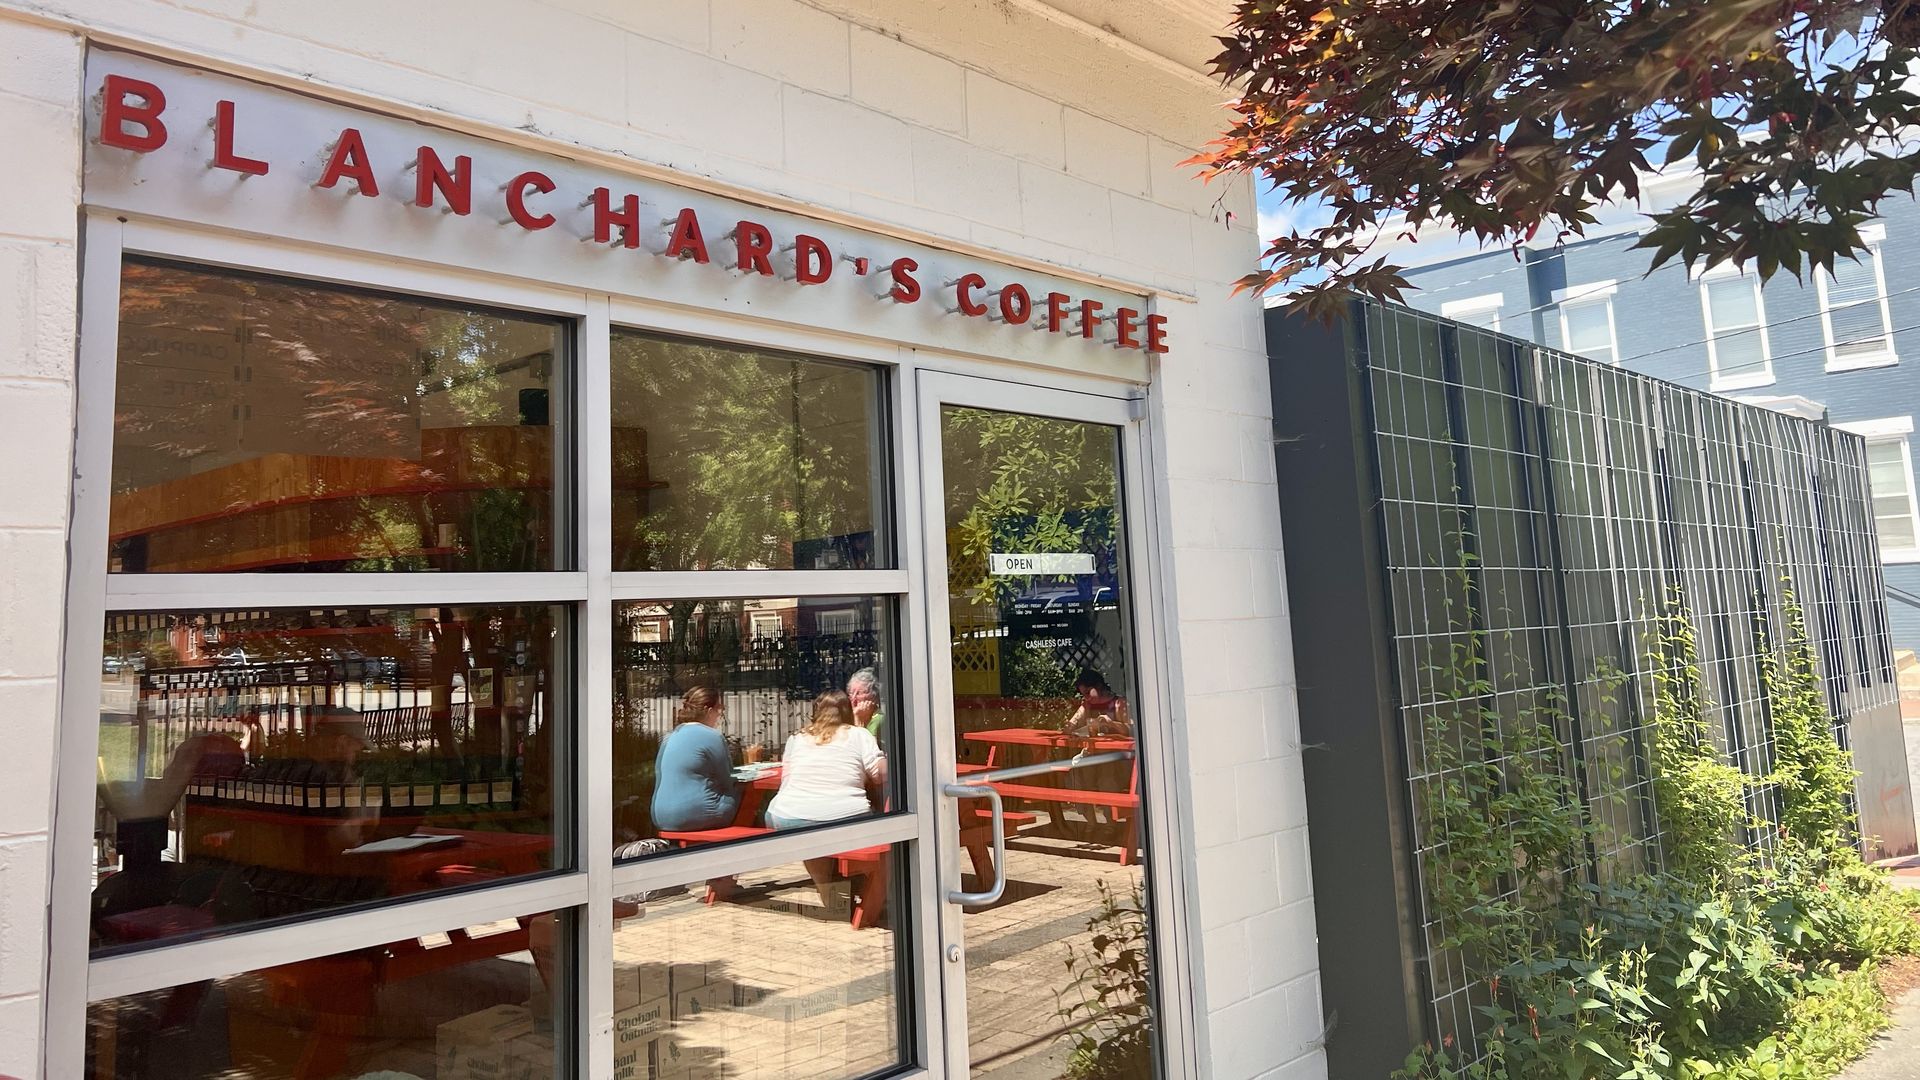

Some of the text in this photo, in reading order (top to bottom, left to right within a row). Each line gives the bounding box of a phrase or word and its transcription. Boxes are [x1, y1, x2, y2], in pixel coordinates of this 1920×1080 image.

[100, 73, 1170, 353] BLANCHARD'S COFFEE
[1006, 558, 1033, 570] OPEN
[1026, 637, 1073, 649] CASHLESS CAFE
[616, 1005, 661, 1032] Chobani
